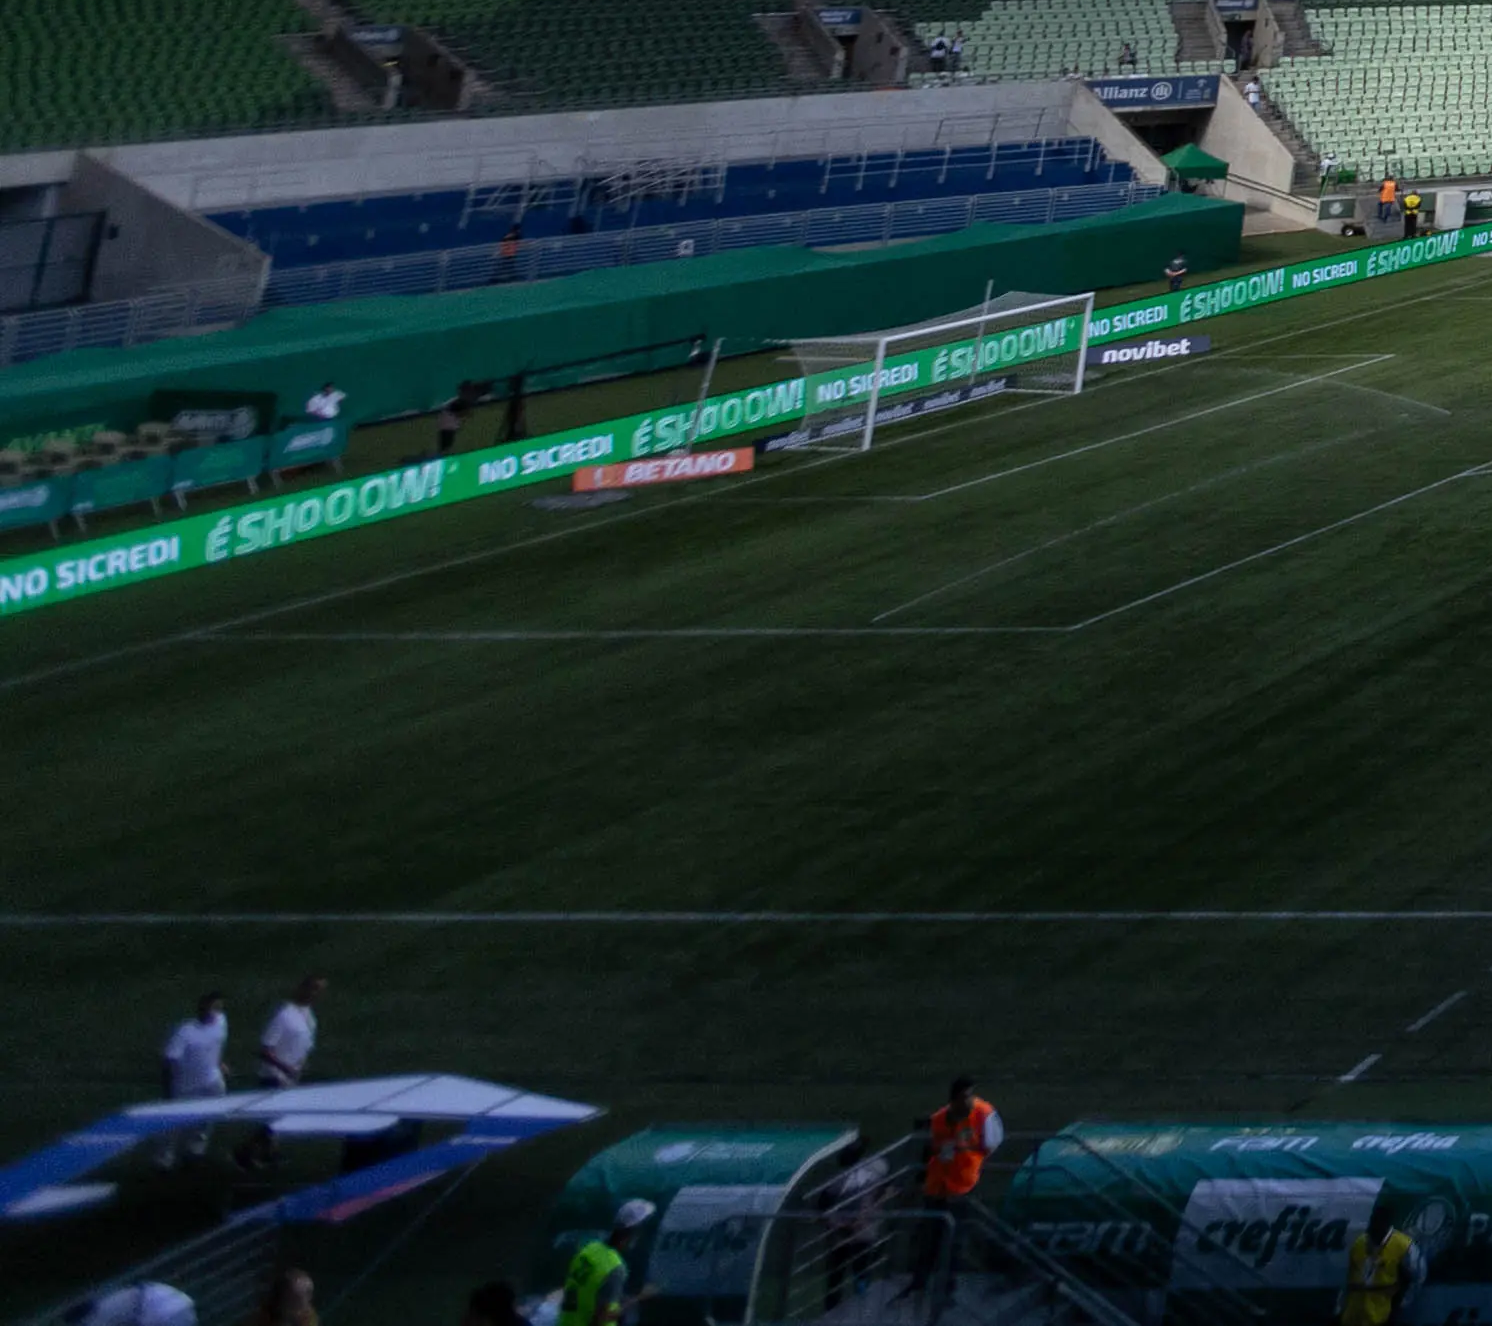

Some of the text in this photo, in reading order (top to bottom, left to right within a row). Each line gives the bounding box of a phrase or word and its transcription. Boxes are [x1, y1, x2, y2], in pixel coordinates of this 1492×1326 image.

[1472, 231, 1488, 248] NO
[1292, 260, 1358, 289] NO SICREDI
[1088, 303, 1169, 339] NO SICREDI
[1102, 337, 1192, 365] novibet
[816, 379, 847, 403] NO
[478, 432, 614, 486] NO SICREDI
[622, 450, 737, 484] BETANO
[55, 536, 181, 592] SICREDI
[1197, 1204, 1351, 1269] crefisa
